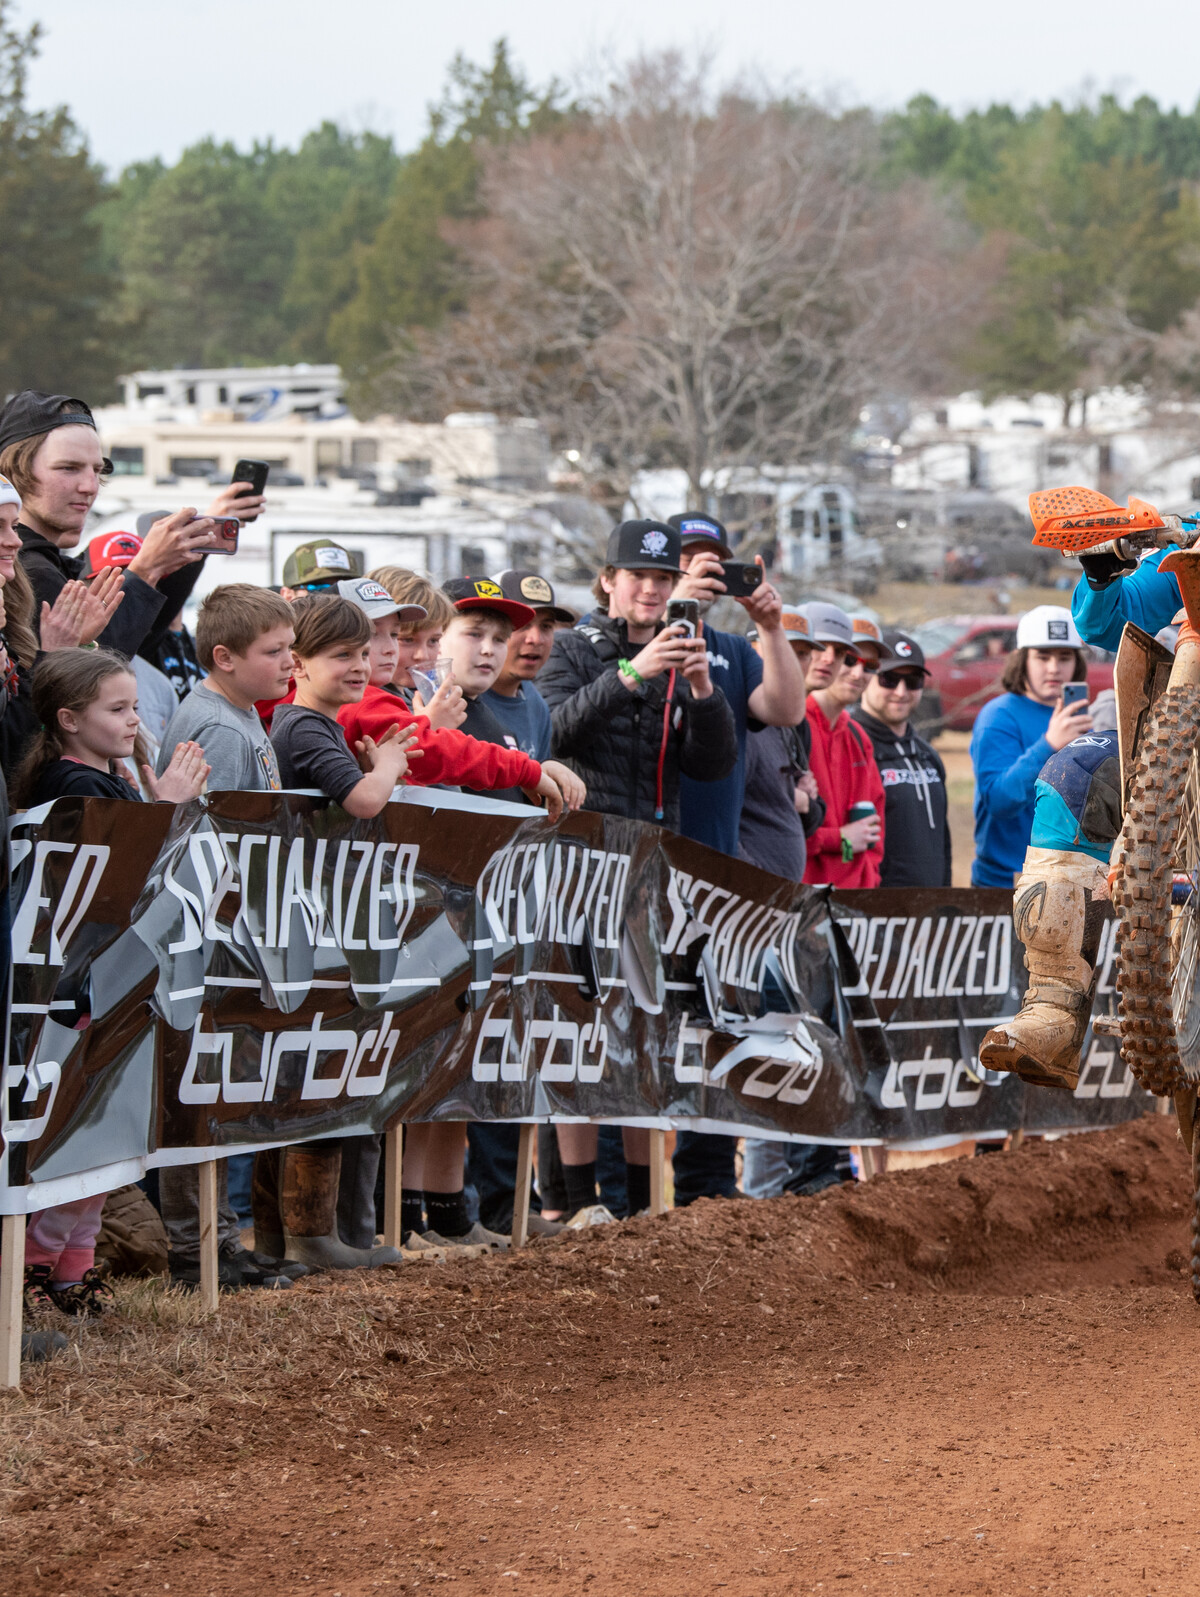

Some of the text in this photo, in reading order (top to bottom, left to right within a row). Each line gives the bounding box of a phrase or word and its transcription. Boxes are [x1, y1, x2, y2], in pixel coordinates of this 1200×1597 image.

[1062, 516, 1131, 529] ACERBIS
[163, 831, 420, 955] SPECIALIZED
[474, 842, 631, 950] SPECIALIZED
[178, 1011, 400, 1105] turbo
[472, 1003, 608, 1084] turbo
